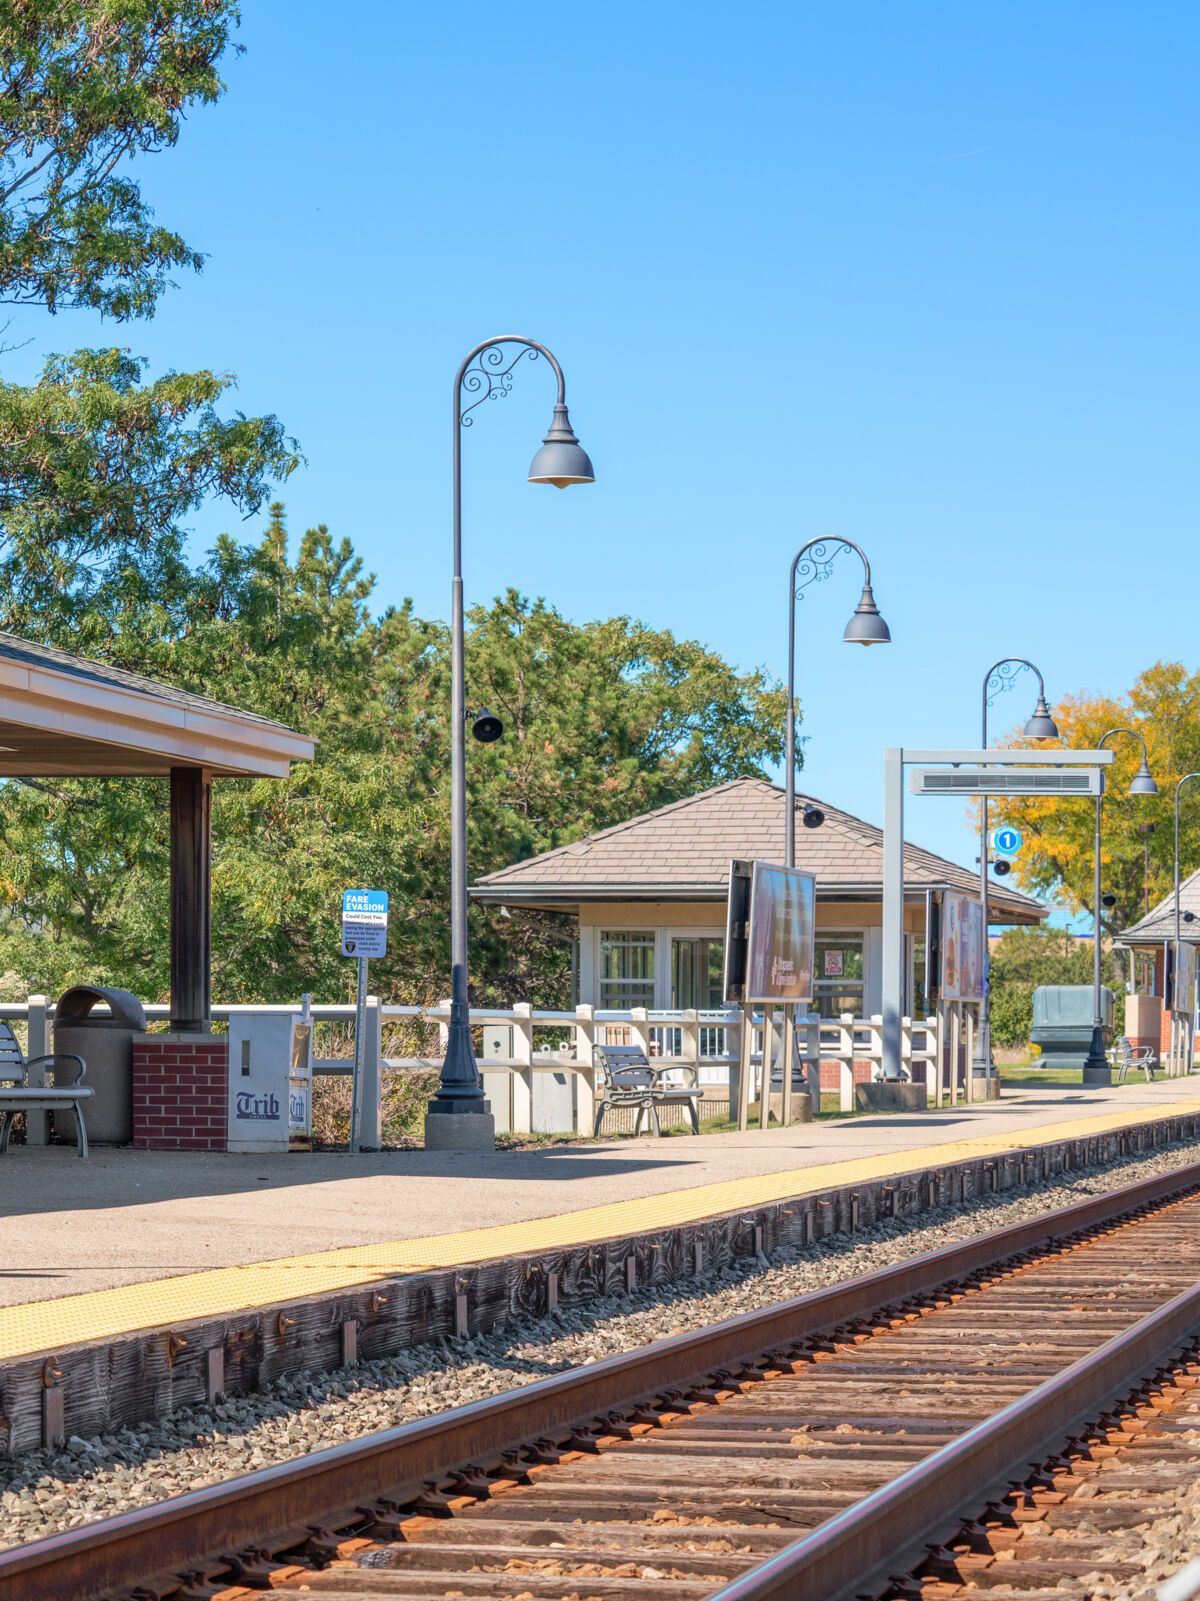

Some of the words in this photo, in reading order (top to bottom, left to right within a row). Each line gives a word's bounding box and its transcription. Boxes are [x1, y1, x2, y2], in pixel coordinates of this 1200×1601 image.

[1003, 834, 1010, 848] 1
[346, 895, 369, 903] FARE
[346, 903, 384, 912] EVASION
[236, 1091, 280, 1115] Trib
[290, 1094, 304, 1118] Trib
